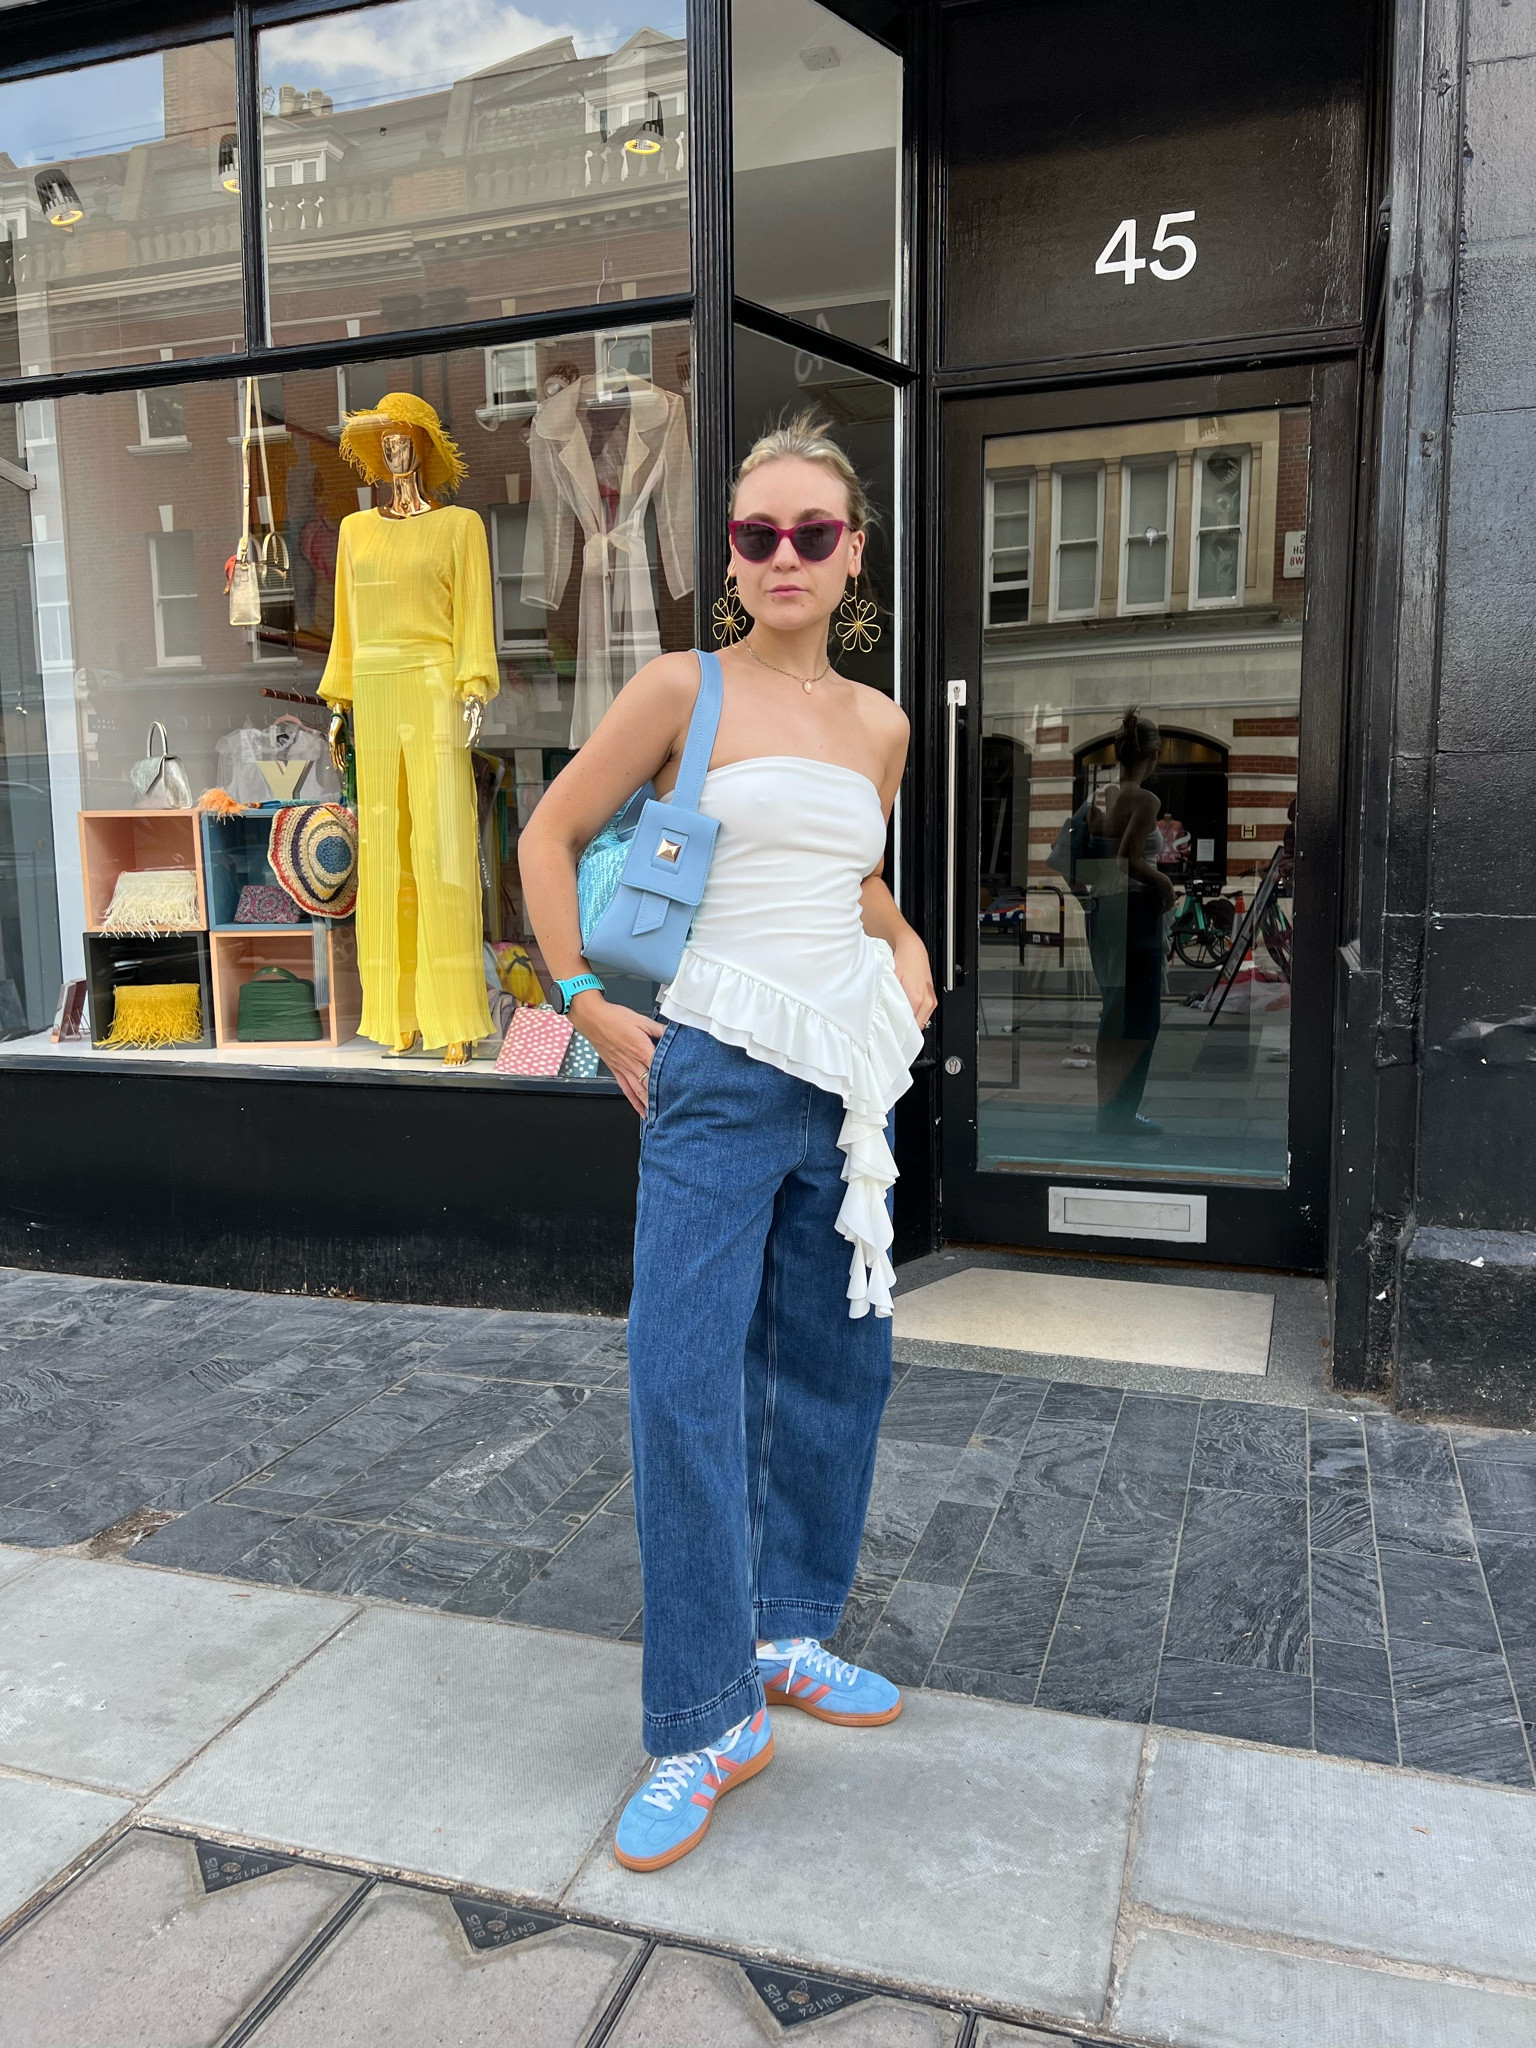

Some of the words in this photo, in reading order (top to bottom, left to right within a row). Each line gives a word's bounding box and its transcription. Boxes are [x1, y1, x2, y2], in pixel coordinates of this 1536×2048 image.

[1095, 210, 1197, 285] 45
[257, 760, 314, 799] Y
[205, 1857, 220, 1880] B125
[225, 1864, 268, 1883] EN124
[466, 1914, 486, 1939] B125
[493, 1921, 537, 1943] EN124
[763, 1983, 790, 2013] B125
[798, 1992, 844, 2018] EN124
